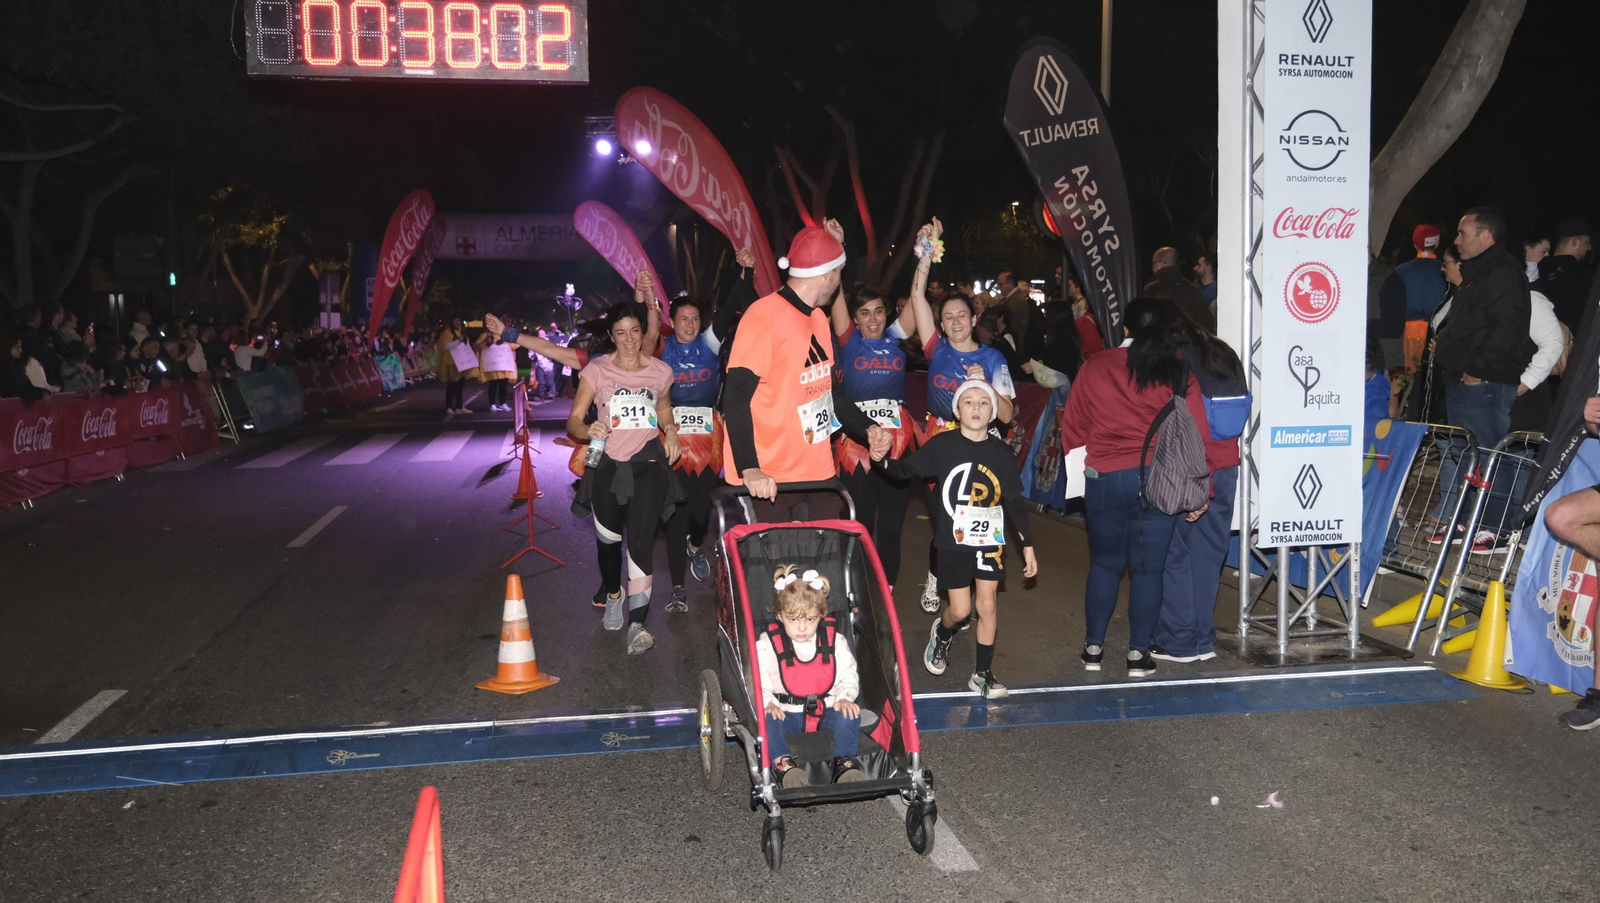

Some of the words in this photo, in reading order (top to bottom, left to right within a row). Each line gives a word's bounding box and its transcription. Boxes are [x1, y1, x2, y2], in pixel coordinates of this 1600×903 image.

[1279, 53, 1354, 68] RENAULT
[1278, 68, 1303, 78] SYRSA
[1304, 69, 1354, 79] AUTOMOCION
[1279, 135, 1349, 146] NISSAN
[1286, 174, 1347, 183] andalmotor.es
[1272, 206, 1361, 239] Coca-Cola
[494, 244, 539, 255] CIUDAD
[853, 356, 904, 371] GALO
[674, 367, 712, 383] ALO
[799, 362, 831, 385] adida
[621, 406, 646, 417] 311
[815, 409, 829, 426] 28
[680, 415, 704, 425] 295
[1273, 429, 1327, 445] Almericar
[970, 520, 990, 533] 29
[1270, 519, 1344, 533] RENAULT
[1270, 534, 1293, 544] SYRSA
[1294, 533, 1342, 543] AUTOMOCION
[1553, 552, 1561, 578] NOBLE
[1561, 648, 1584, 662] CIUDAD
[1584, 654, 1592, 663] DE
